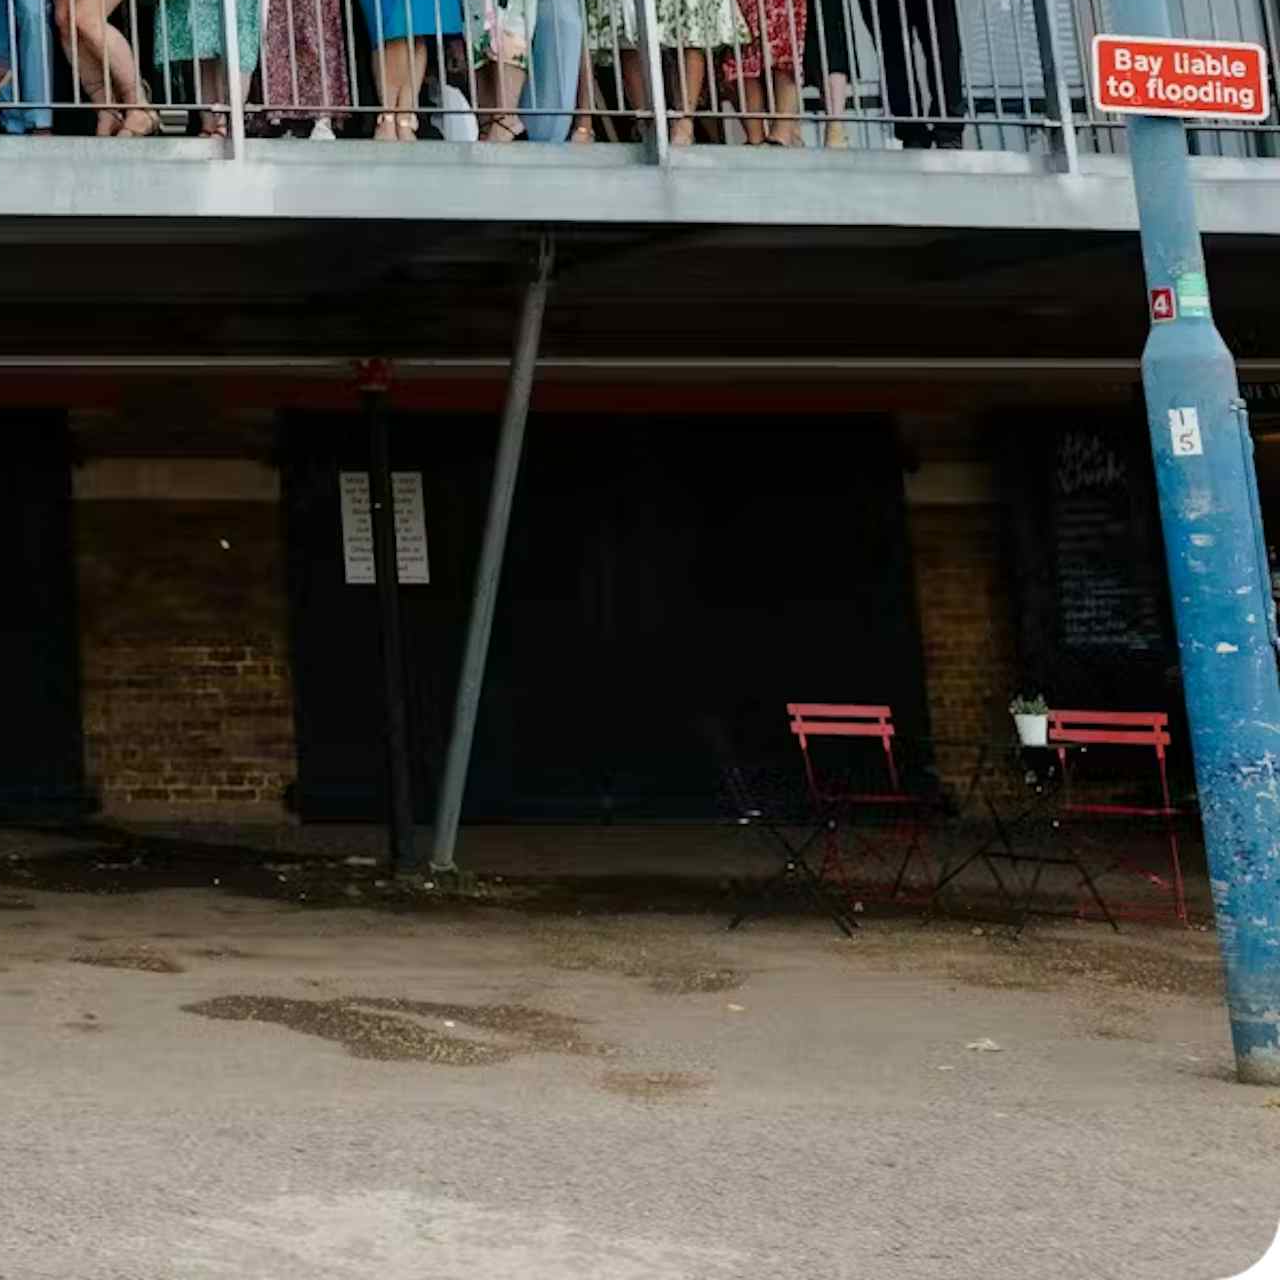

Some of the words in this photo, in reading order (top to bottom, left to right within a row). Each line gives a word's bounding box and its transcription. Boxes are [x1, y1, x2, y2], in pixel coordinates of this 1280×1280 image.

[1113, 48, 1163, 76] Bay
[1173, 51, 1247, 78] liable
[1106, 75, 1135, 98] to
[1145, 77, 1255, 110] flooding
[1153, 294, 1170, 317] 4
